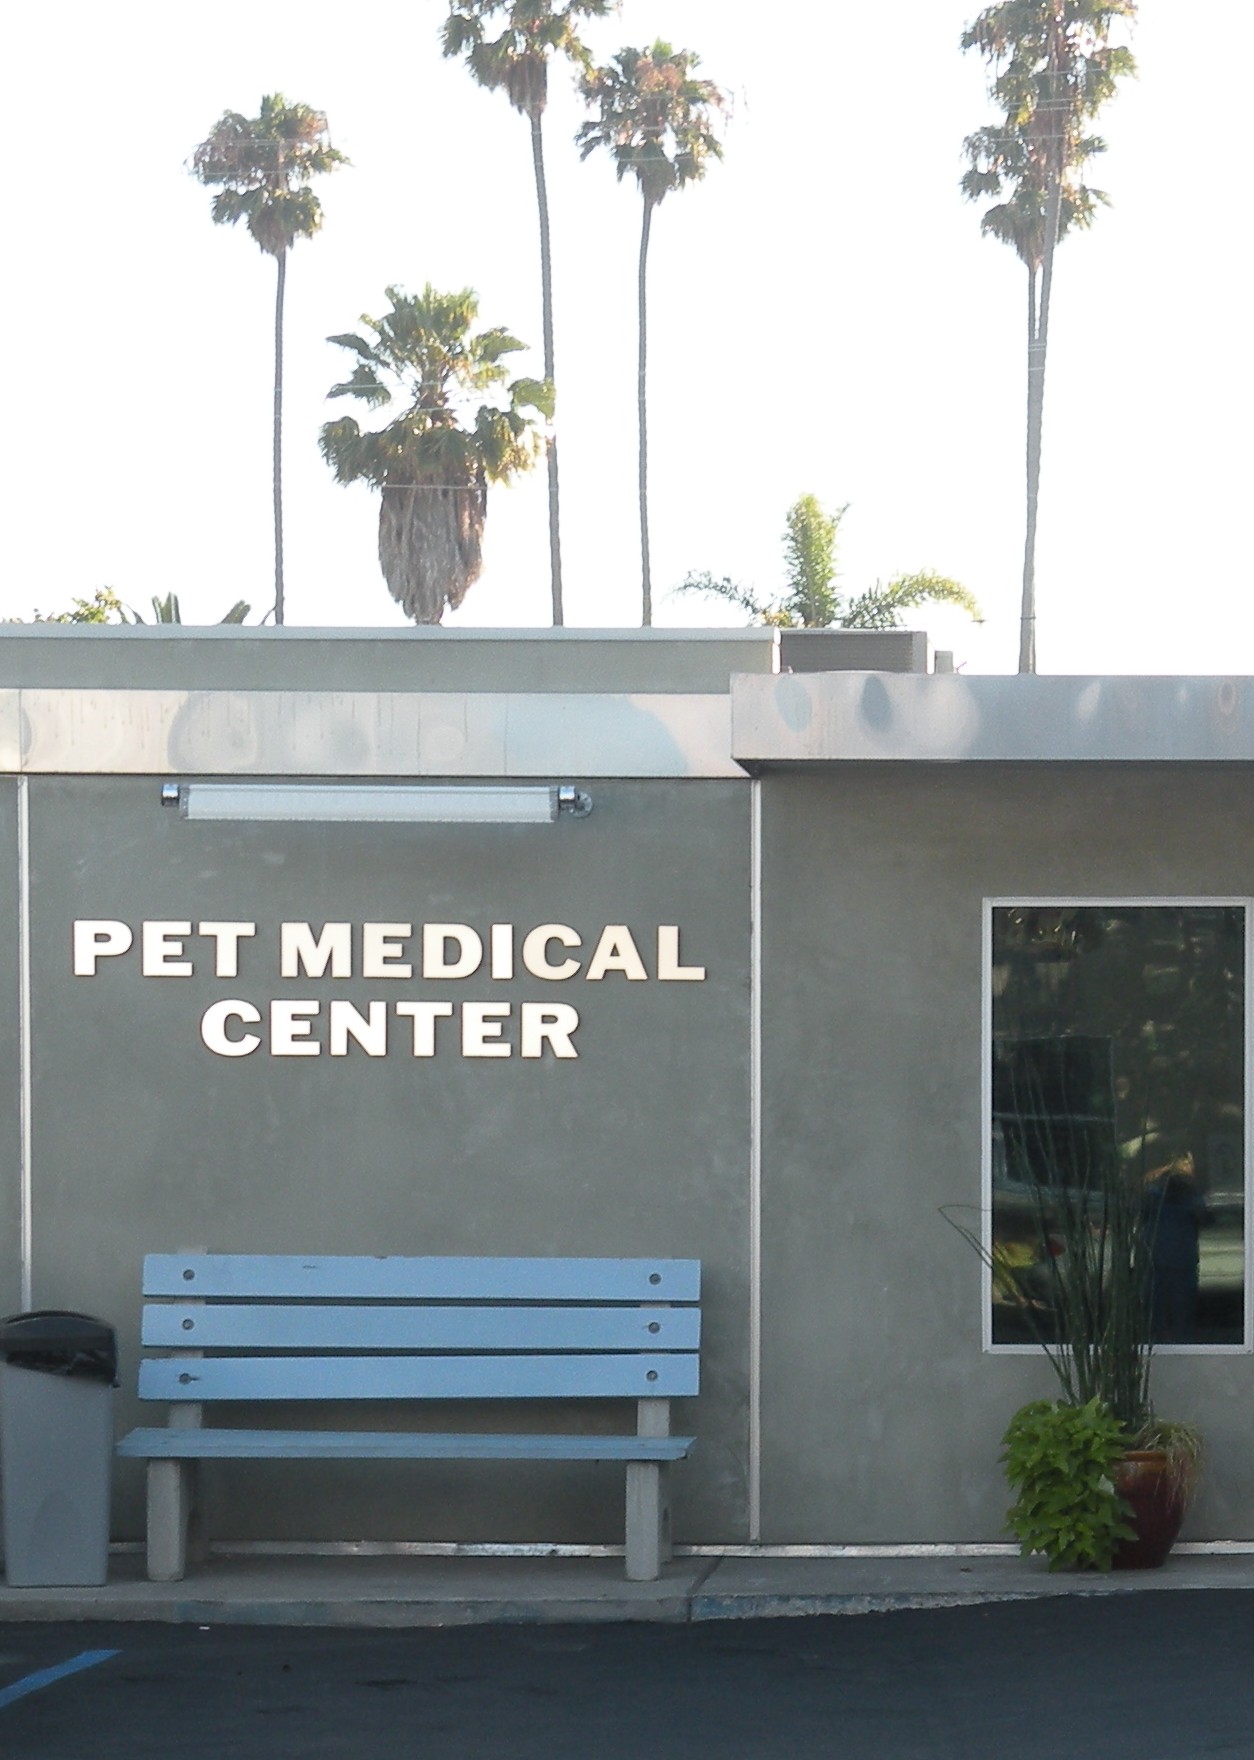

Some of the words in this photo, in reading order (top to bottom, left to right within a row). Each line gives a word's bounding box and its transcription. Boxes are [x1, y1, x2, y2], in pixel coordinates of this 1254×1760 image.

[73, 919, 256, 977] PET
[281, 922, 706, 981] MEDICAL
[200, 999, 580, 1058] CENTER
